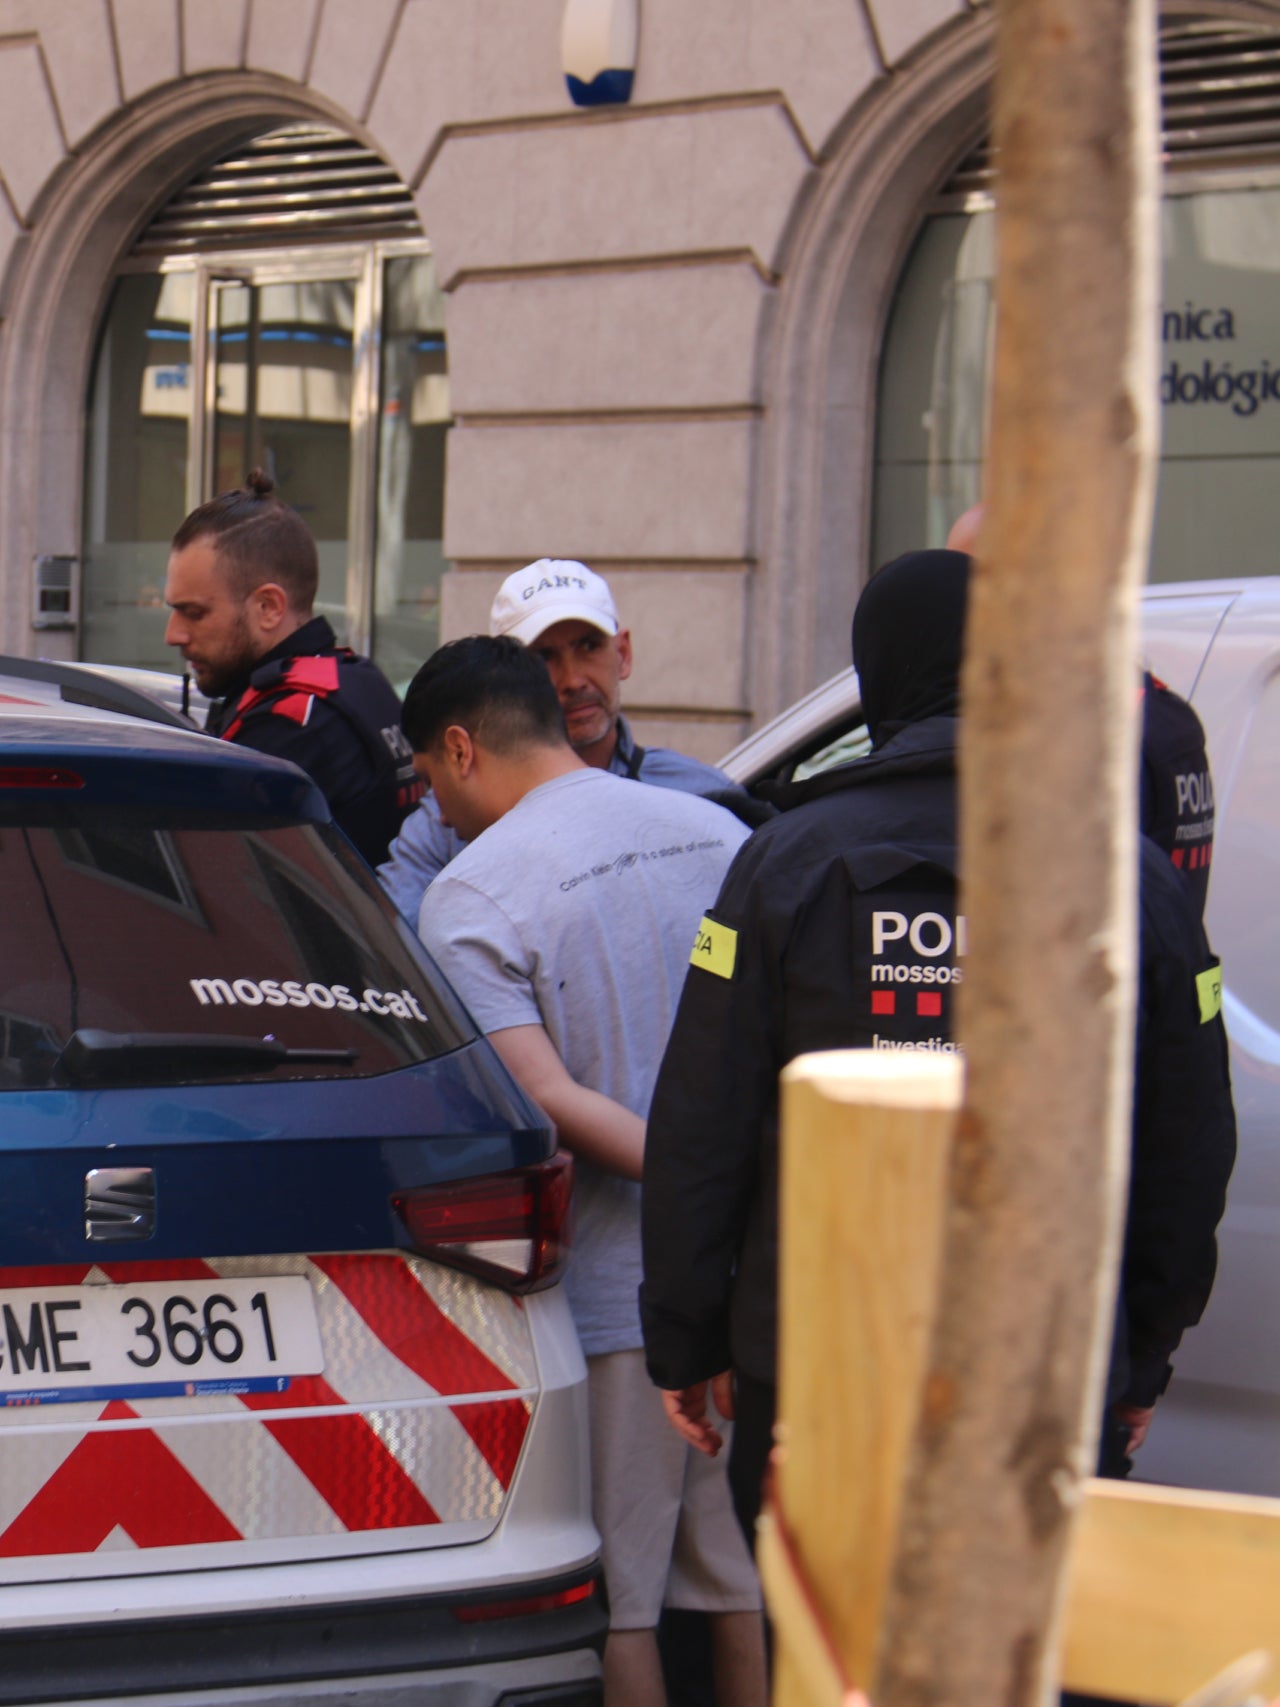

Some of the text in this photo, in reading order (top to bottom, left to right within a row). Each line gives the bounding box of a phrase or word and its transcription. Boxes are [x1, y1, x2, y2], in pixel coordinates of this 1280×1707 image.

[522, 575, 587, 601] GANT
[189, 978, 428, 1022] mossos.cat
[120, 1291, 279, 1368] 3661
